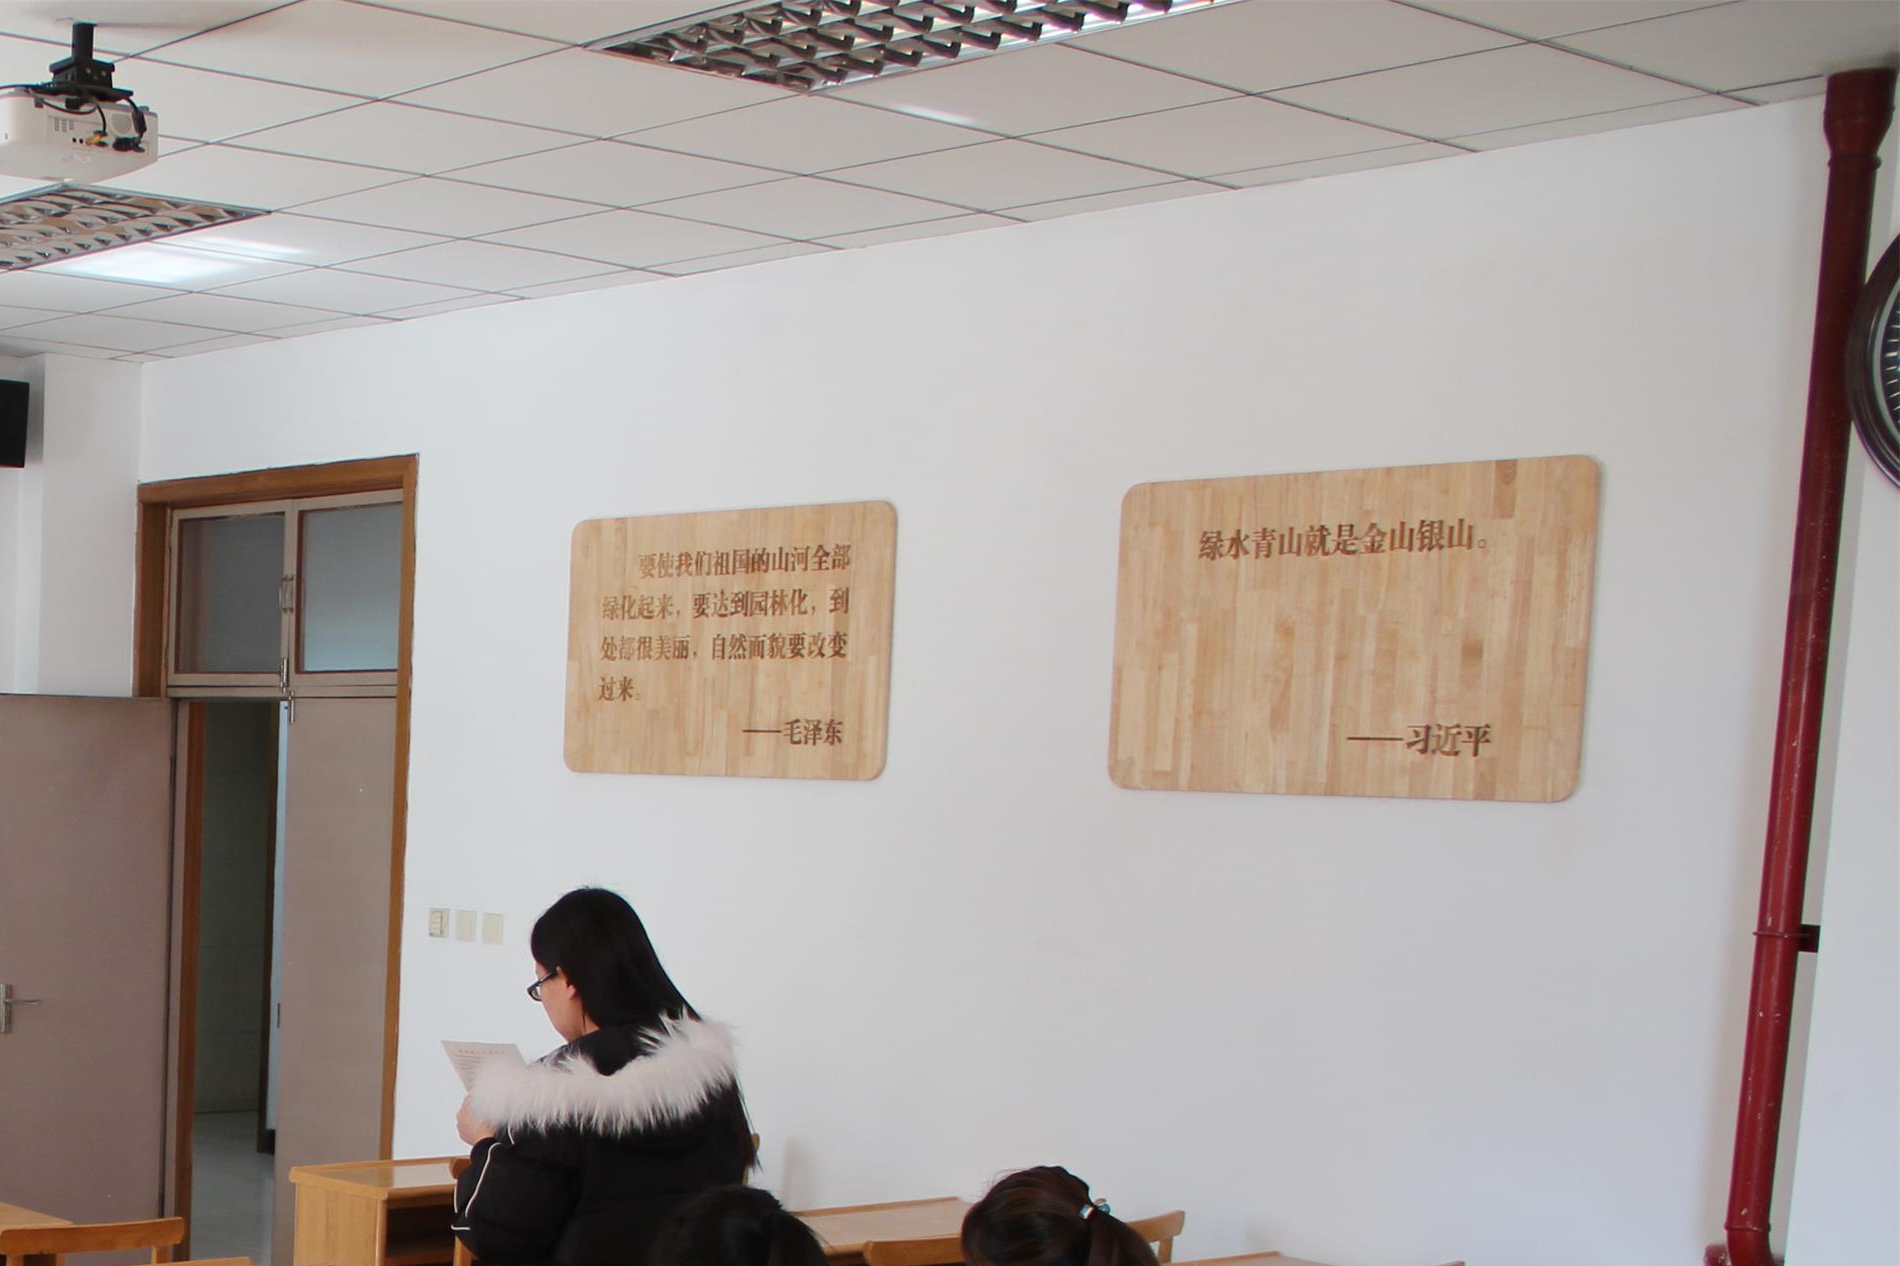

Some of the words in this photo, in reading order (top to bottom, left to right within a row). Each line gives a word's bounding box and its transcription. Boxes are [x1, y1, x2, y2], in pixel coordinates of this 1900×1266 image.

[1197, 518, 1489, 561] 绿水青山就是金山银山。
[638, 543, 852, 579] 要使我们祖国的山河全部
[601, 587, 851, 621] 绿化起来，要达到园林化，到
[599, 630, 849, 662] 处都很美丽，自然面貌要改变
[597, 675, 643, 703] 过来。
